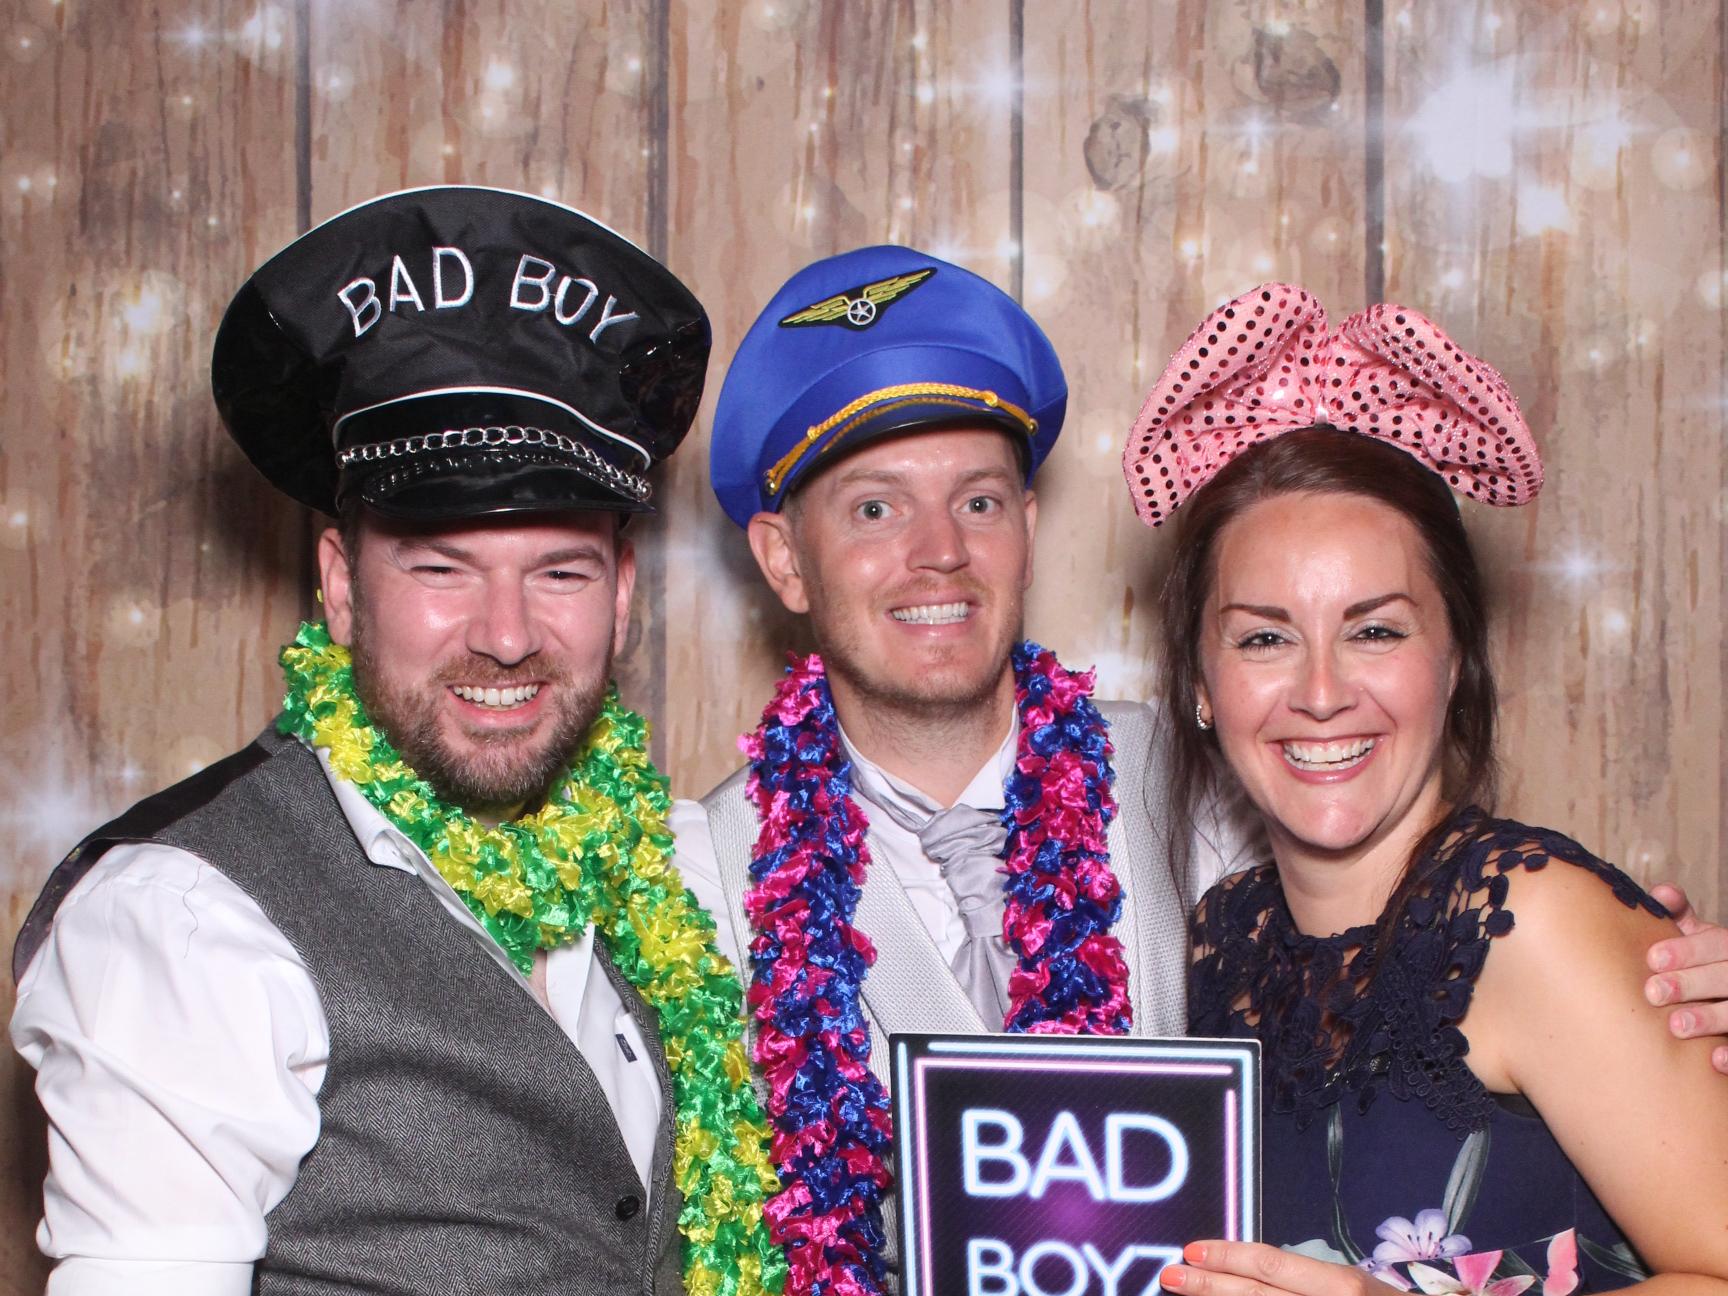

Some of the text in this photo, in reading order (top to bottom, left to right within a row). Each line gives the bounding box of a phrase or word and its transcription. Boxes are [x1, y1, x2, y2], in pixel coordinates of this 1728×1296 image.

[337, 247, 639, 343] BAD BOY
[961, 1107, 1190, 1203] BAD
